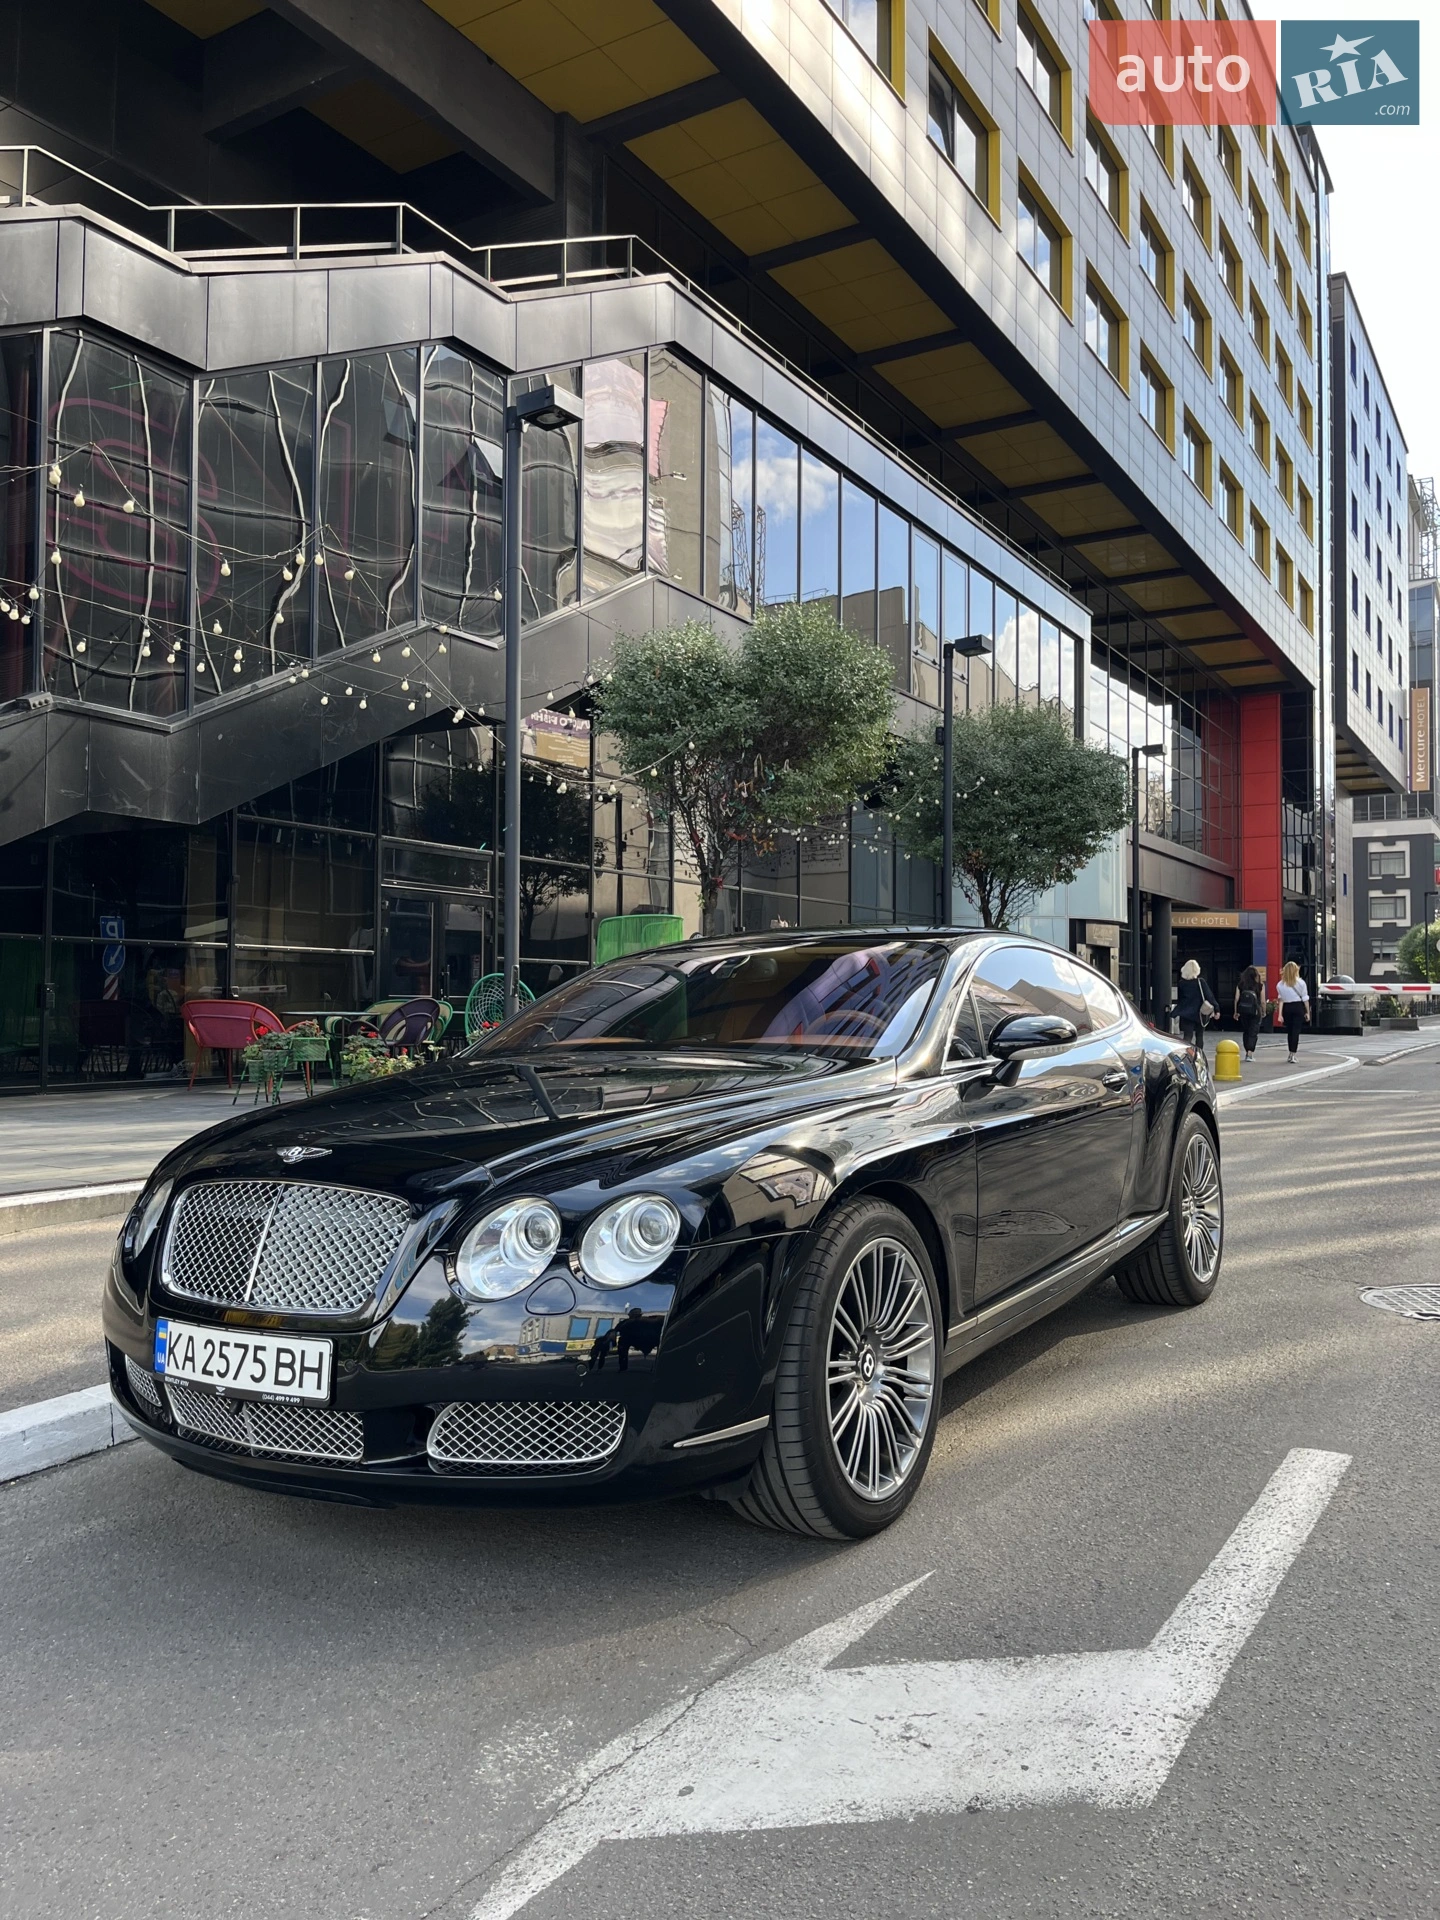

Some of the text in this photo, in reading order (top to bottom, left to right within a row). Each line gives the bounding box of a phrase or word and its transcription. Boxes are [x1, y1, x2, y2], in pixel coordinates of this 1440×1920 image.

[1416, 696, 1425, 783] Mercure HOTEL
[1171, 916, 1230, 926] cure HOTEL
[157, 1351, 165, 1365] UA
